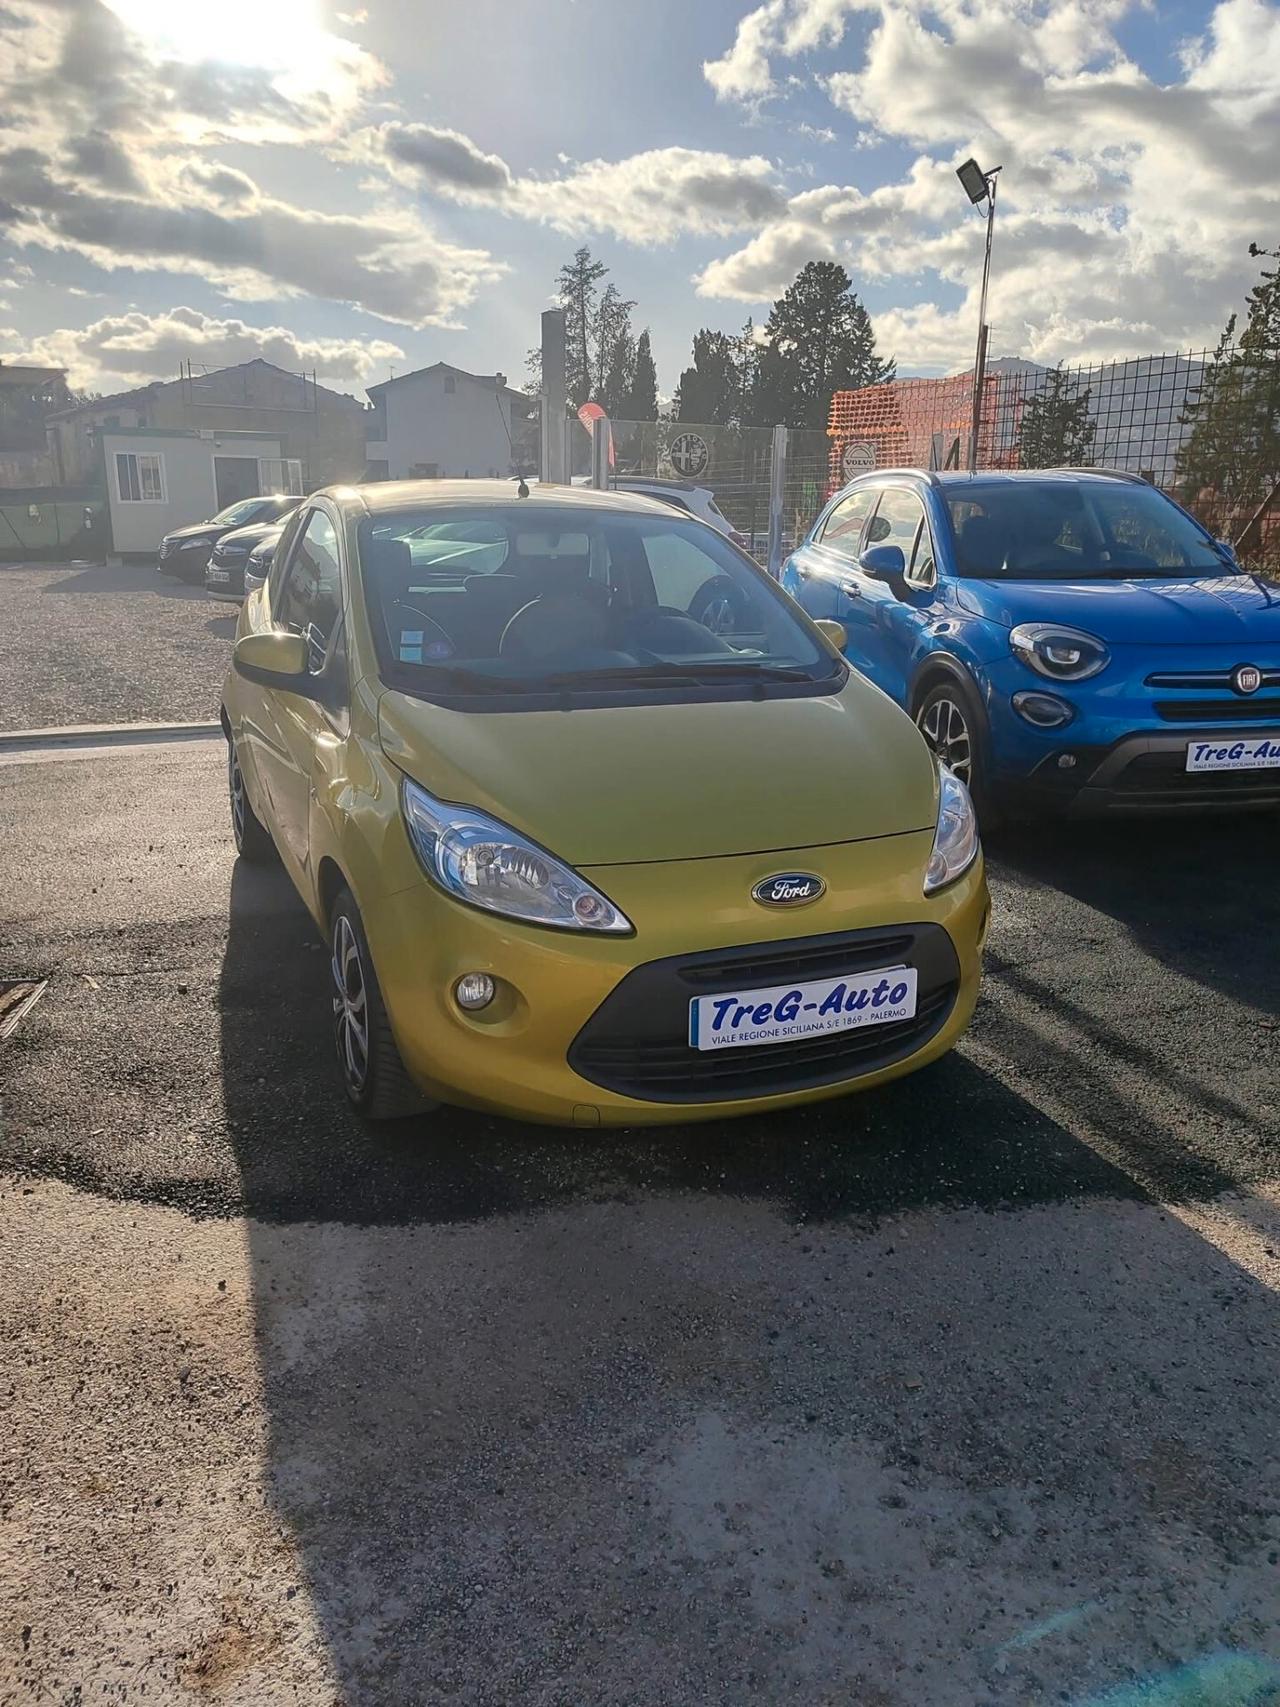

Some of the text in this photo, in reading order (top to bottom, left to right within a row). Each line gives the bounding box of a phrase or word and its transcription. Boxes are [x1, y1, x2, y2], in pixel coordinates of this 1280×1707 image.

[1242, 673, 1256, 686] FIAT
[771, 879, 811, 900] Ford
[711, 979, 908, 1031] TreG-Auto
[712, 1034, 737, 1045] VIALE
[738, 1028, 780, 1041] REGIONE
[782, 1023, 825, 1036] SICILIANA
[826, 1019, 840, 1030] S/E
[842, 1015, 862, 1026] 1869
[870, 1008, 907, 1021] PALERMO
